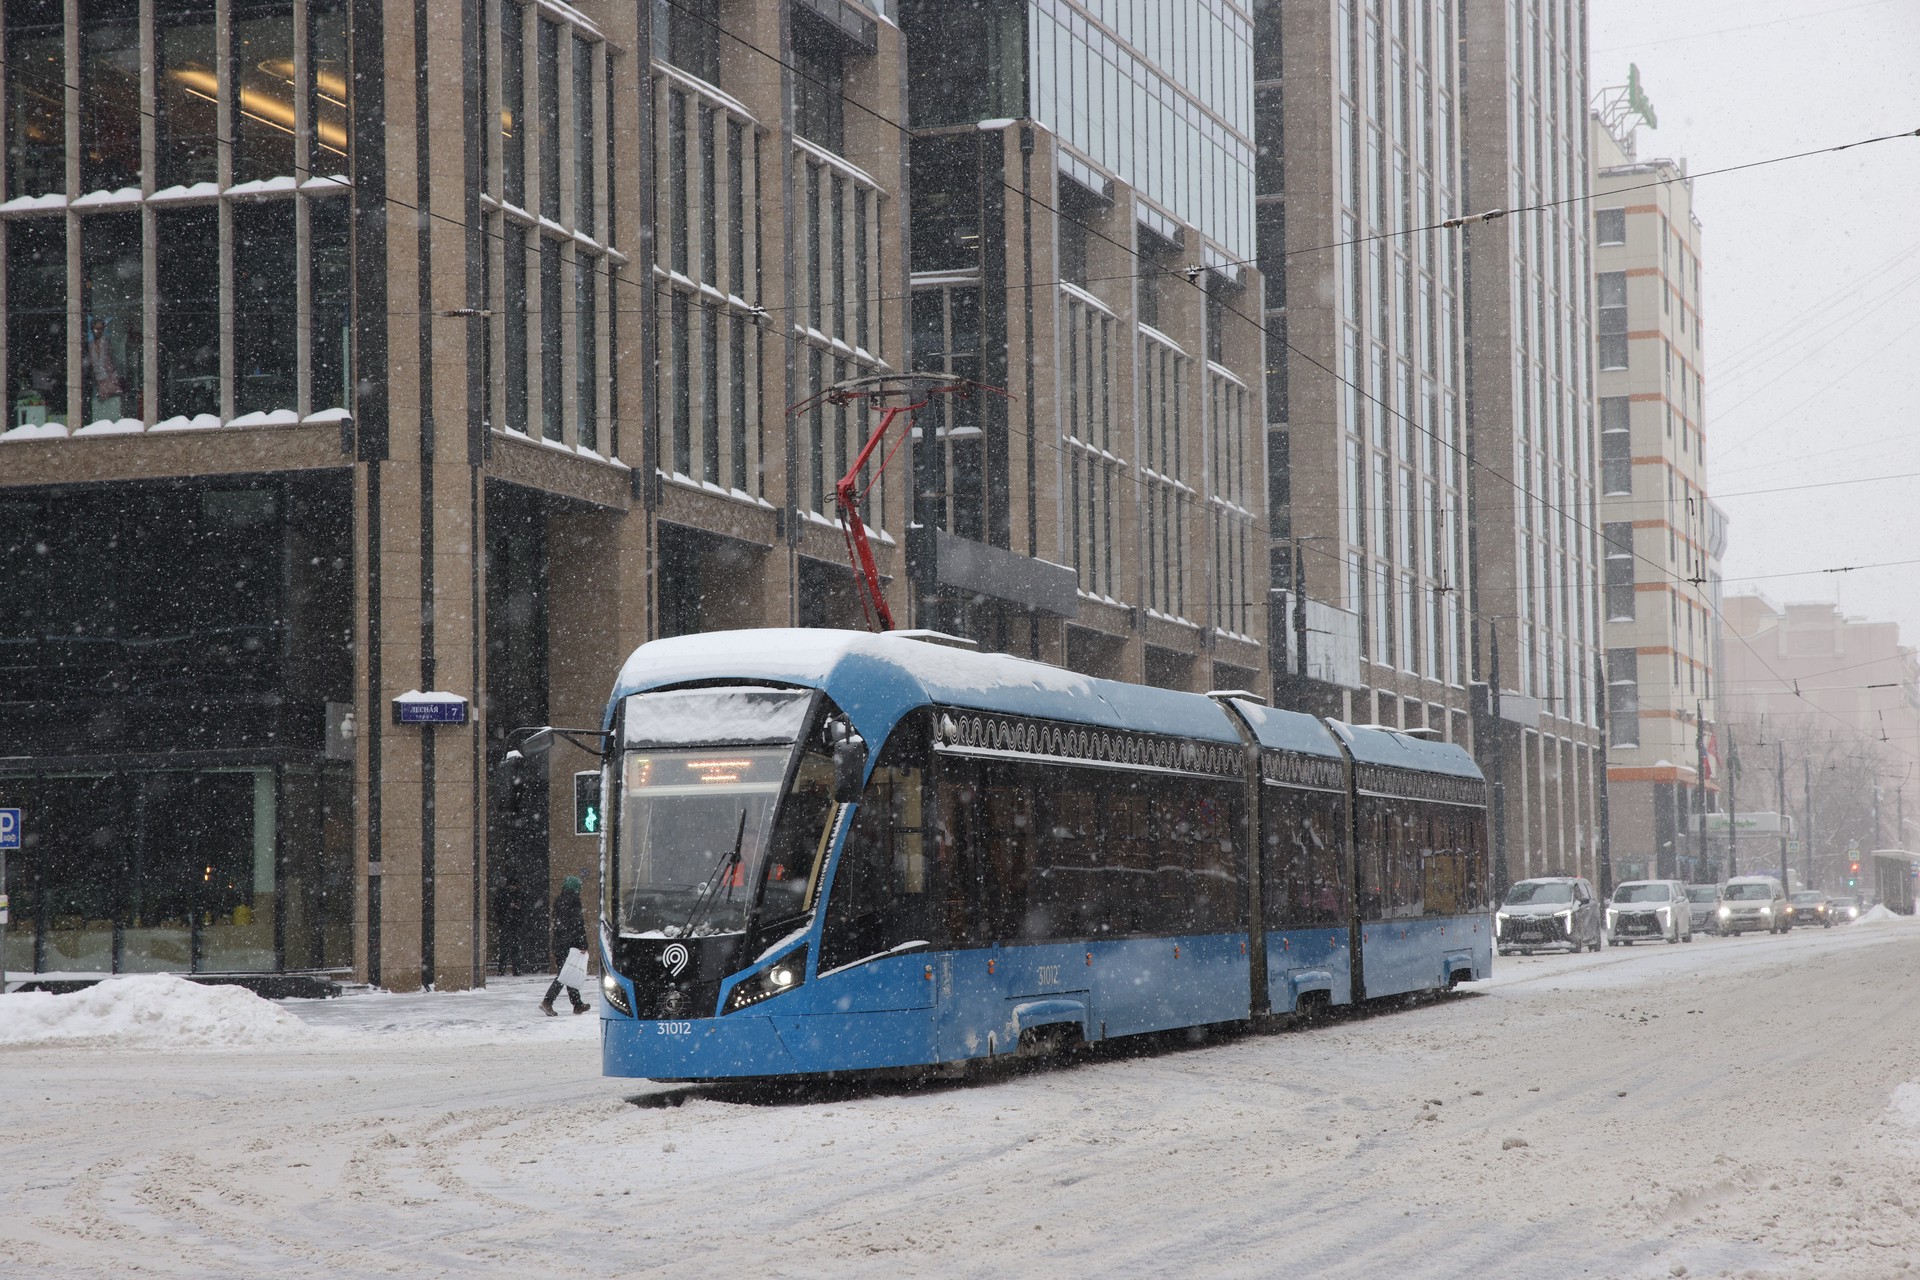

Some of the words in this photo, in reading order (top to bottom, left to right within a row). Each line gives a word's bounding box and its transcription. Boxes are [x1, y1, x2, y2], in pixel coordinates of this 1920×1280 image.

[451, 707, 459, 717] 7
[1038, 965, 1059, 986] 31012
[657, 1022, 692, 1035] 31012
